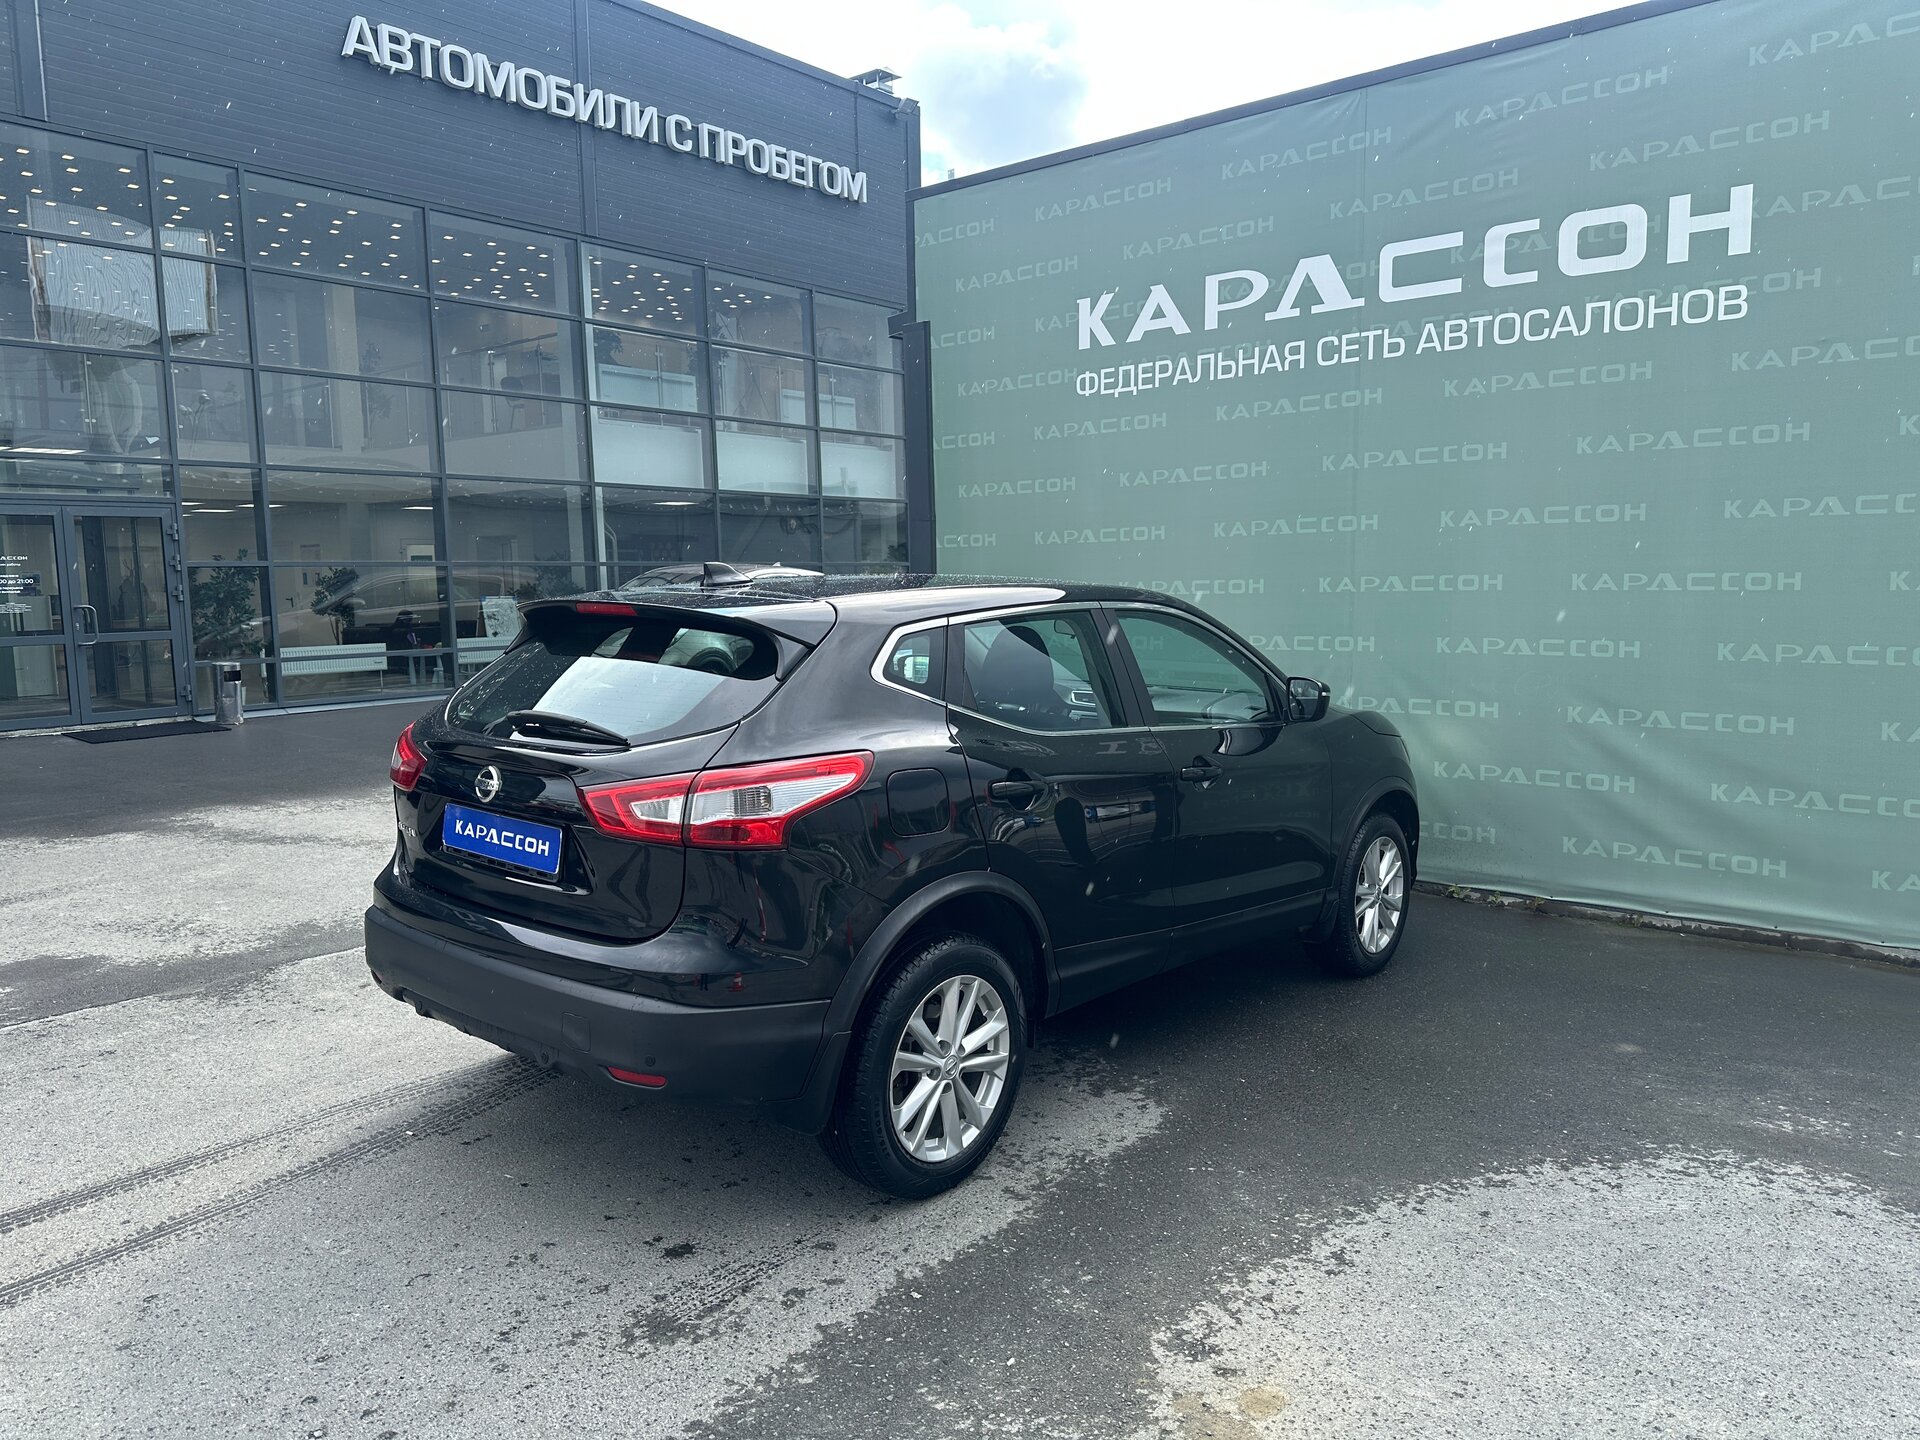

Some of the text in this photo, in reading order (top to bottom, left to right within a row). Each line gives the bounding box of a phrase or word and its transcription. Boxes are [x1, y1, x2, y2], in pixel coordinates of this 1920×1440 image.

[341, 15, 867, 203] АВТОМОБИЛИ С ПРОБЕГОМ
[1075, 284, 1748, 398] ФЕДЕРАЛЬНАЯ СЕТЬ АВТОСАЛОНОВ
